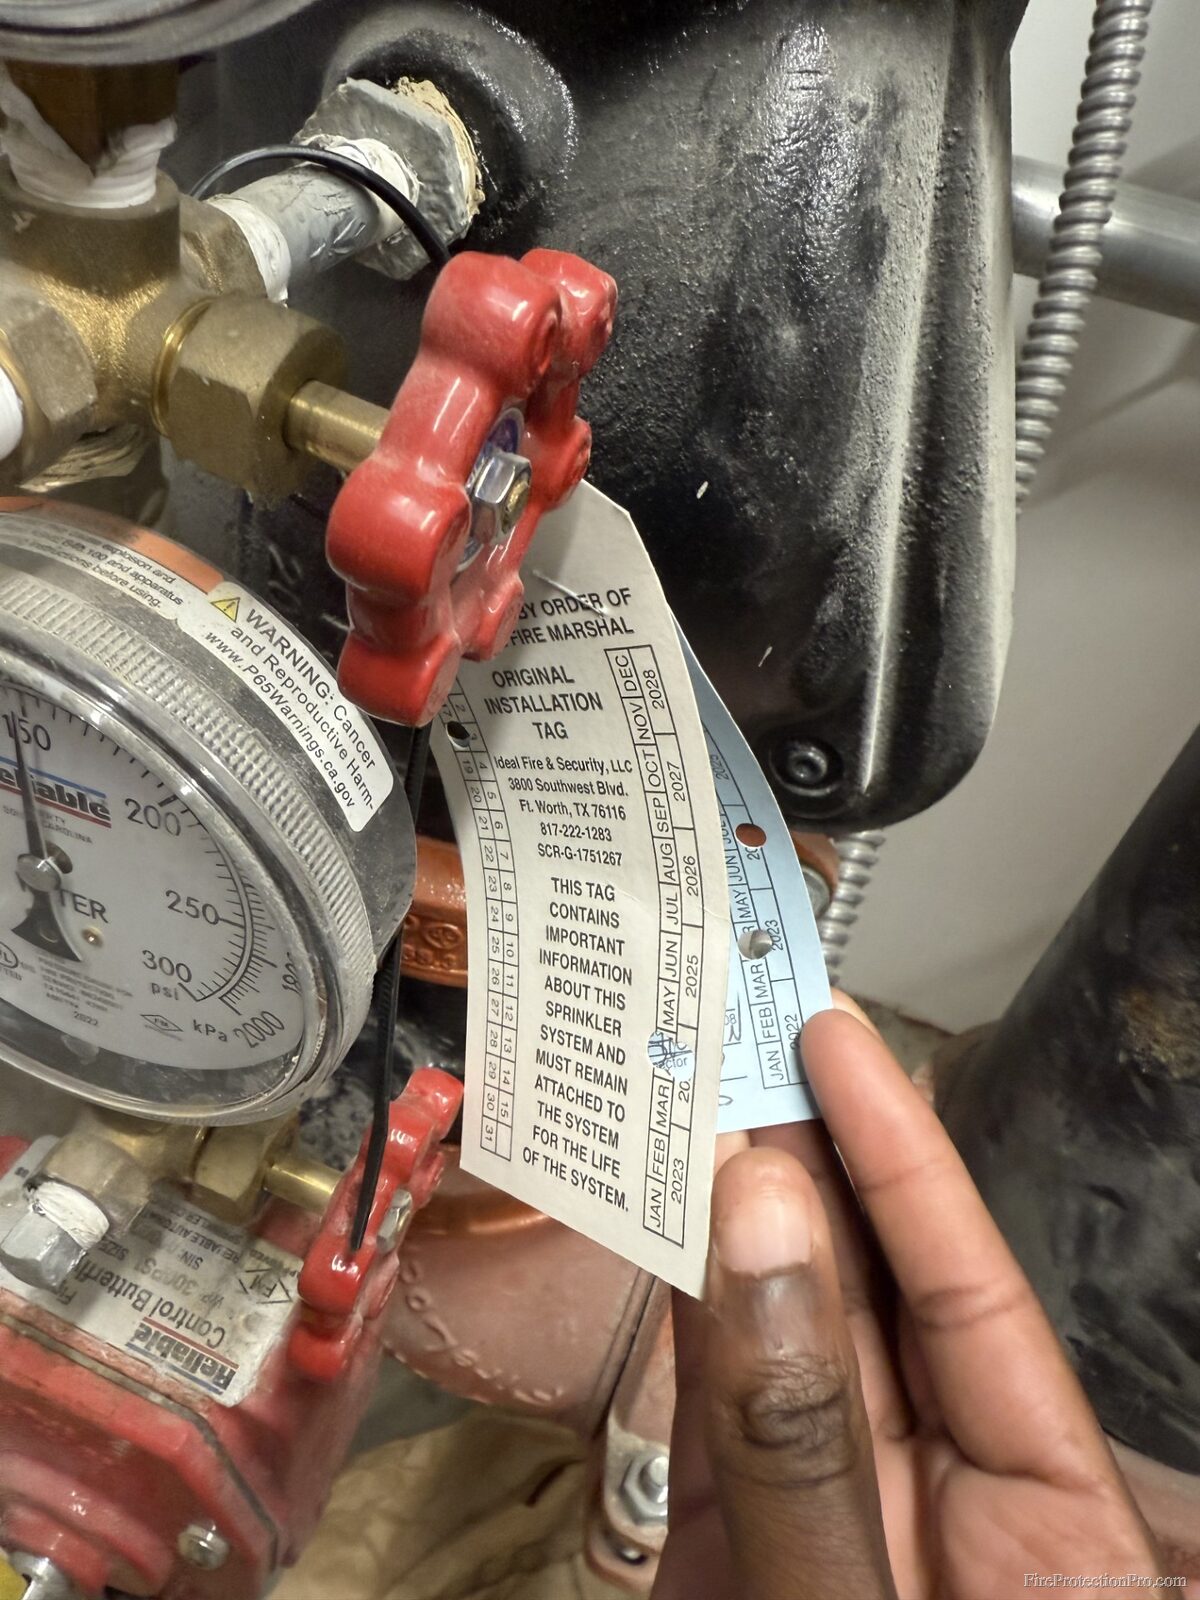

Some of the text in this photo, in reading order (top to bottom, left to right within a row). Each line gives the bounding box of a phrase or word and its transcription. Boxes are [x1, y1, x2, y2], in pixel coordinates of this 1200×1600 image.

[93, 564, 129, 587] before
[129, 584, 162, 609] using.
[129, 569, 184, 606] apparatus
[541, 592, 605, 616] ORDER
[606, 587, 632, 607] OF
[510, 616, 635, 646] FIRE MARSHAL
[492, 665, 576, 688] ORIGINAL
[614, 654, 638, 693] DEC
[642, 668, 665, 710] 2028
[246, 609, 376, 770] WARNING: Cancer
[484, 691, 604, 715] INSTALLATION
[2, 712, 51, 751] 150
[204, 631, 355, 808] www.P65Warnings.ca.gov
[231, 626, 374, 811] and Reproductive Harm-
[532, 721, 569, 740] TAG
[631, 701, 652, 740] NOV
[462, 759, 474, 775] 19
[494, 756, 633, 776] Ideal Fire & Security, LLC
[642, 749, 662, 788] OCT
[666, 761, 686, 802] 2027
[470, 787, 482, 803] 20
[487, 791, 497, 800] 5
[508, 777, 630, 797] 3800 Southwest Blvd.
[124, 798, 181, 837] 200
[478, 815, 489, 831] 21
[495, 820, 504, 830] 6
[519, 799, 627, 822] Ft. Worth, TX 76116
[652, 797, 670, 833] SEP
[540, 822, 613, 842] 817-222-1283
[483, 845, 494, 864] 22
[500, 851, 509, 860] 7
[537, 842, 623, 867] SCR-G-1751267
[659, 842, 677, 882] AUG
[724, 855, 743, 883] JUN
[488, 875, 498, 893] 23
[503, 881, 512, 891] 8
[550, 876, 615, 902] THIS TAG
[682, 855, 699, 897] 2026
[165, 889, 220, 926] 250
[490, 906, 500, 923] 24
[505, 912, 514, 922] 9
[550, 902, 620, 929] CONTAINS
[666, 892, 679, 926] JUL
[732, 889, 751, 919] MAY
[491, 936, 500, 954] 25
[505, 942, 515, 958] 10
[545, 925, 625, 957] IMPORTANT
[764, 919, 784, 951] 2023
[142, 949, 192, 983] 300
[539, 948, 633, 986] INFORMATION
[664, 940, 679, 978] JUN
[491, 967, 500, 985] 26
[505, 974, 514, 988] 11
[685, 954, 699, 999] 2025
[751, 962, 769, 999] MAR
[490, 998, 500, 1017] 27
[544, 975, 626, 1011] ABOUT THIS
[662, 985, 677, 1026] MAY
[505, 1005, 514, 1022] 12
[545, 1000, 622, 1038] SPRINKLER
[759, 1006, 777, 1039] FEB
[192, 1018, 228, 1042] kPa
[232, 1010, 285, 1049] 2000
[490, 1029, 498, 1048] 28
[540, 1024, 593, 1052] SYSTEM
[596, 1042, 626, 1066] AND
[503, 1037, 513, 1054] 13
[488, 1061, 497, 1080] 29
[502, 1069, 511, 1086] 14
[535, 1048, 628, 1096] MUST REMAIN
[767, 1050, 784, 1081] JAN
[486, 1092, 496, 1111] 30
[534, 1074, 625, 1123] ATTACHED TO
[655, 1083, 671, 1128] MAR
[677, 1077, 692, 1104] 20
[500, 1101, 509, 1118] 15
[537, 1100, 619, 1150] THE SYSTEM
[485, 1124, 494, 1142] 31
[533, 1125, 621, 1179] FOR THE LIFE
[653, 1138, 666, 1177] FEB
[522, 1146, 629, 1213] OF THE SYSTEM.
[671, 1158, 685, 1205] 2023
[649, 1188, 663, 1228] JAN
[155, 1296, 226, 1350] Control
[133, 1322, 237, 1391] Reliable
